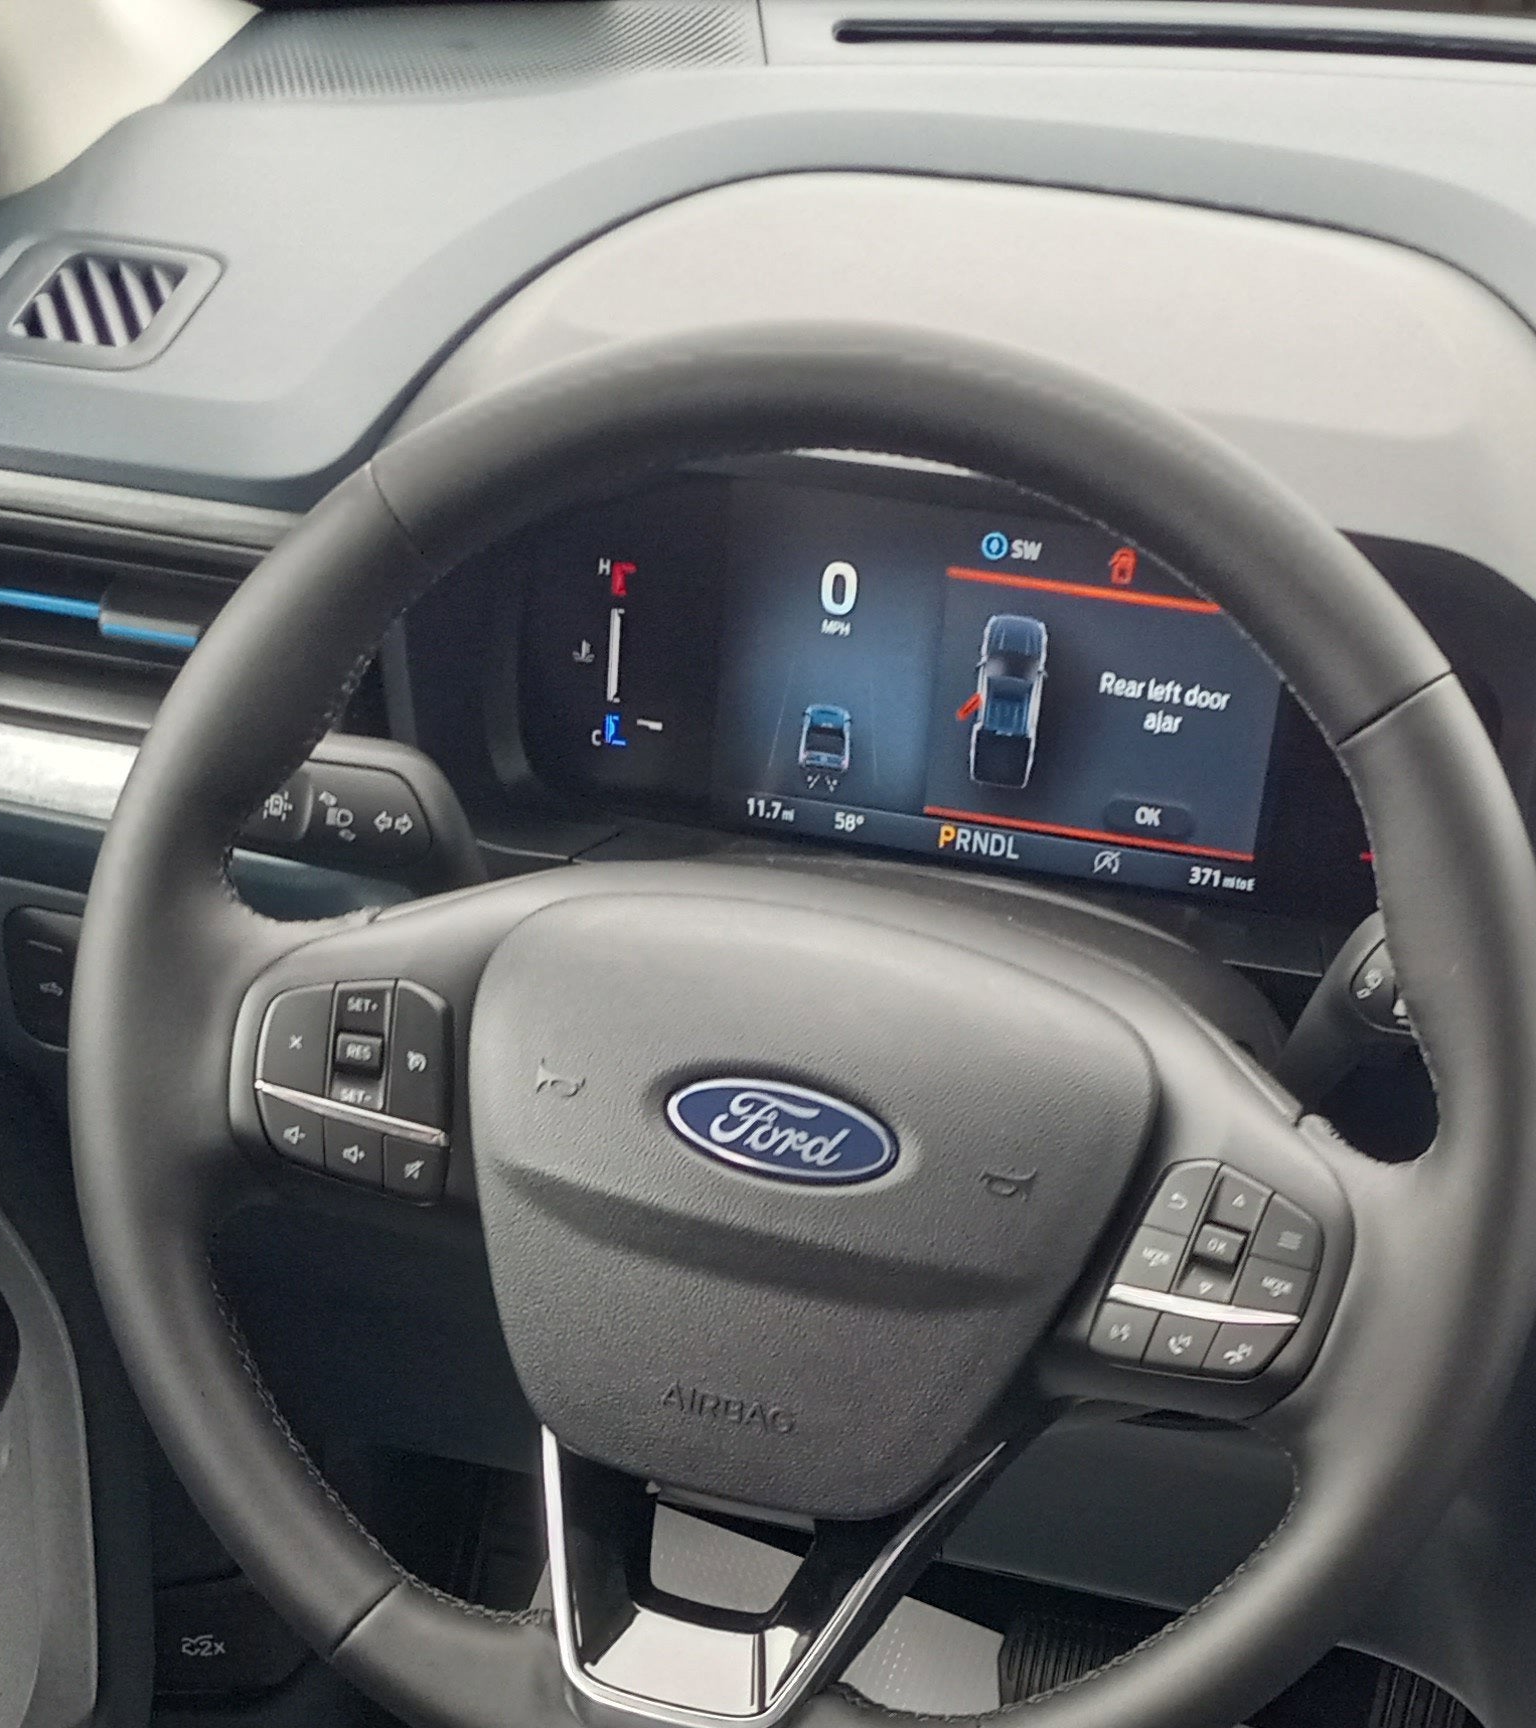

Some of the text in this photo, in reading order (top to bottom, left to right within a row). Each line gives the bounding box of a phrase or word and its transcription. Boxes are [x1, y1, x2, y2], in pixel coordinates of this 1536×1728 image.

[1010, 538, 1043, 561] SW
[597, 557, 612, 576] H
[820, 560, 860, 617] 0
[820, 619, 852, 638] MPH
[1098, 670, 1231, 711] Rear left door
[1142, 709, 1183, 735] ajar
[590, 729, 603, 747] C
[746, 797, 782, 820] 11.7
[1134, 805, 1162, 827] OK
[937, 823, 1020, 860] PRNDL
[1187, 865, 1222, 888] 371
[708, 1089, 853, 1169] Ford
[1206, 1237, 1227, 1255] OK
[662, 1380, 797, 1435] AIRBAG
